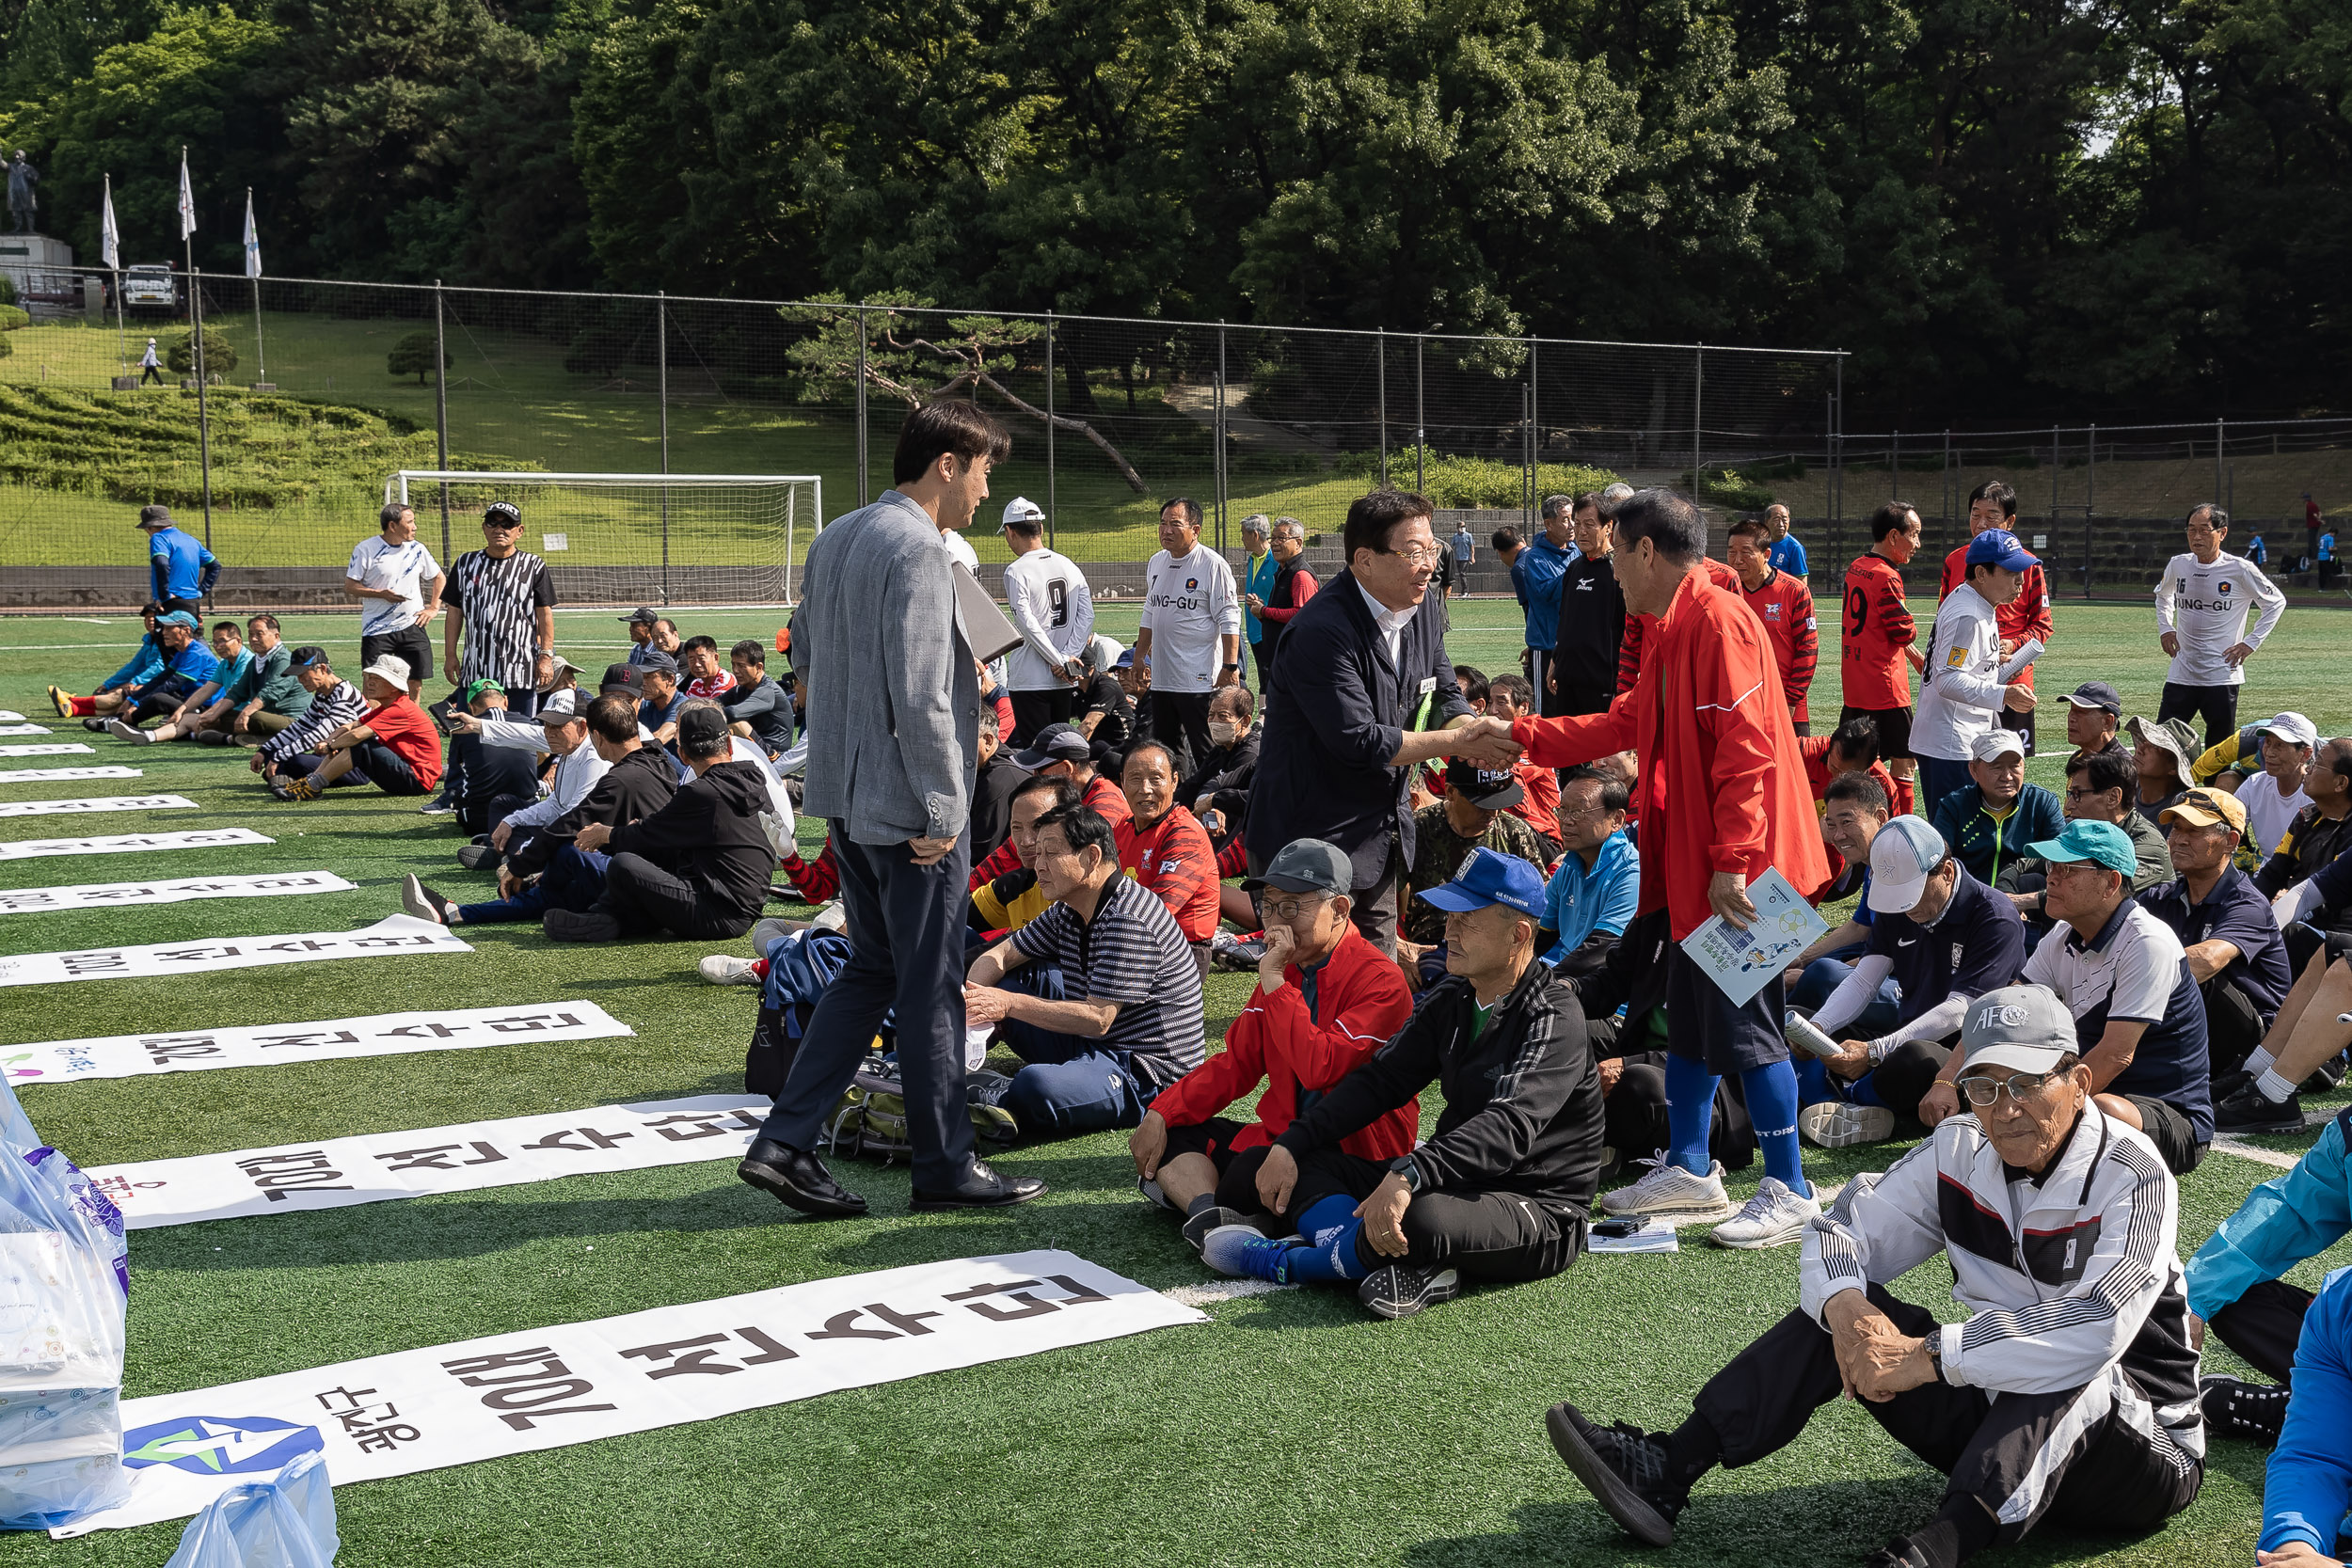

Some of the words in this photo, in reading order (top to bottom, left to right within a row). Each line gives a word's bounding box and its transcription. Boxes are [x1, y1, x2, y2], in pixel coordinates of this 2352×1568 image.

[1046, 577, 1069, 631] 9
[621, 669, 631, 682] B
[77, 878, 322, 900] 선수단
[59, 951, 130, 975] 70대
[153, 935, 435, 961] 선수단
[139, 1036, 227, 1066] 70대
[252, 1013, 587, 1049] 선수단
[234, 1149, 355, 1203] 70대
[373, 1110, 763, 1172] 선수단
[315, 1386, 421, 1454] 광진구
[439, 1346, 619, 1433] 70대
[618, 1275, 1113, 1381] 선수단
